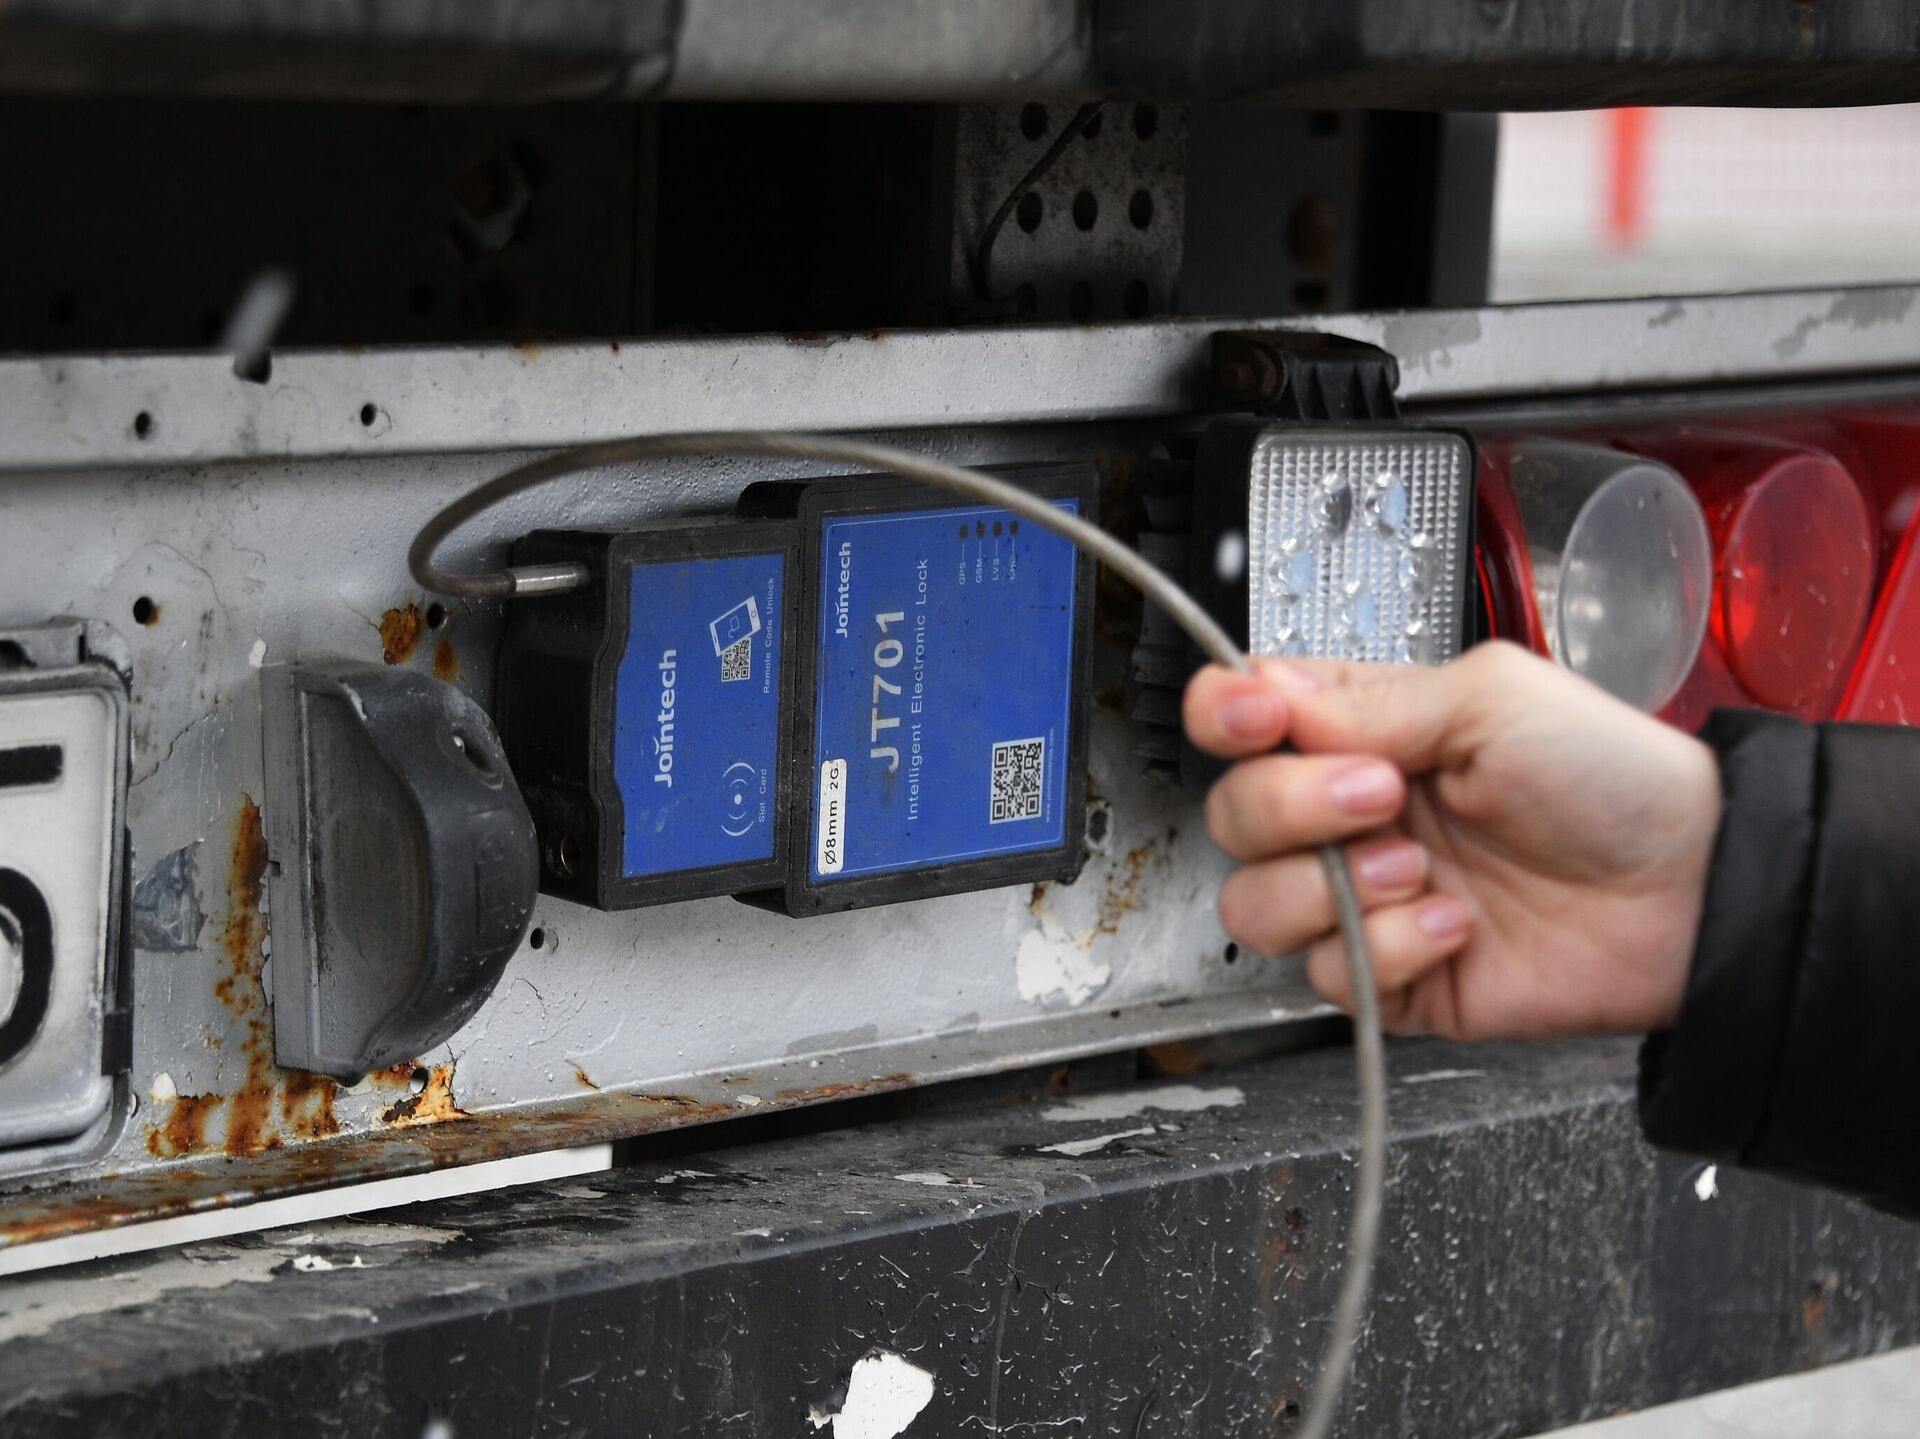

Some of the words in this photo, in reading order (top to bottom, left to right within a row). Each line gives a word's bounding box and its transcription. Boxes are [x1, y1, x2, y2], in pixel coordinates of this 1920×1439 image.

[916, 558, 929, 604] Lock
[958, 561, 967, 586] GPS
[975, 557, 984, 584] GSM
[991, 557, 1000, 582] LVS
[766, 577, 775, 615] Unlock
[835, 542, 852, 638] Jointech
[765, 619, 774, 648] Code
[763, 652, 773, 694] Remote
[910, 614, 927, 714] Electronic
[870, 611, 905, 773] JT701
[653, 648, 678, 788] Jointech
[759, 768, 769, 795] Card
[829, 767, 839, 791] 2G
[907, 722, 924, 821] Intelligent
[757, 802, 767, 824] Slot
